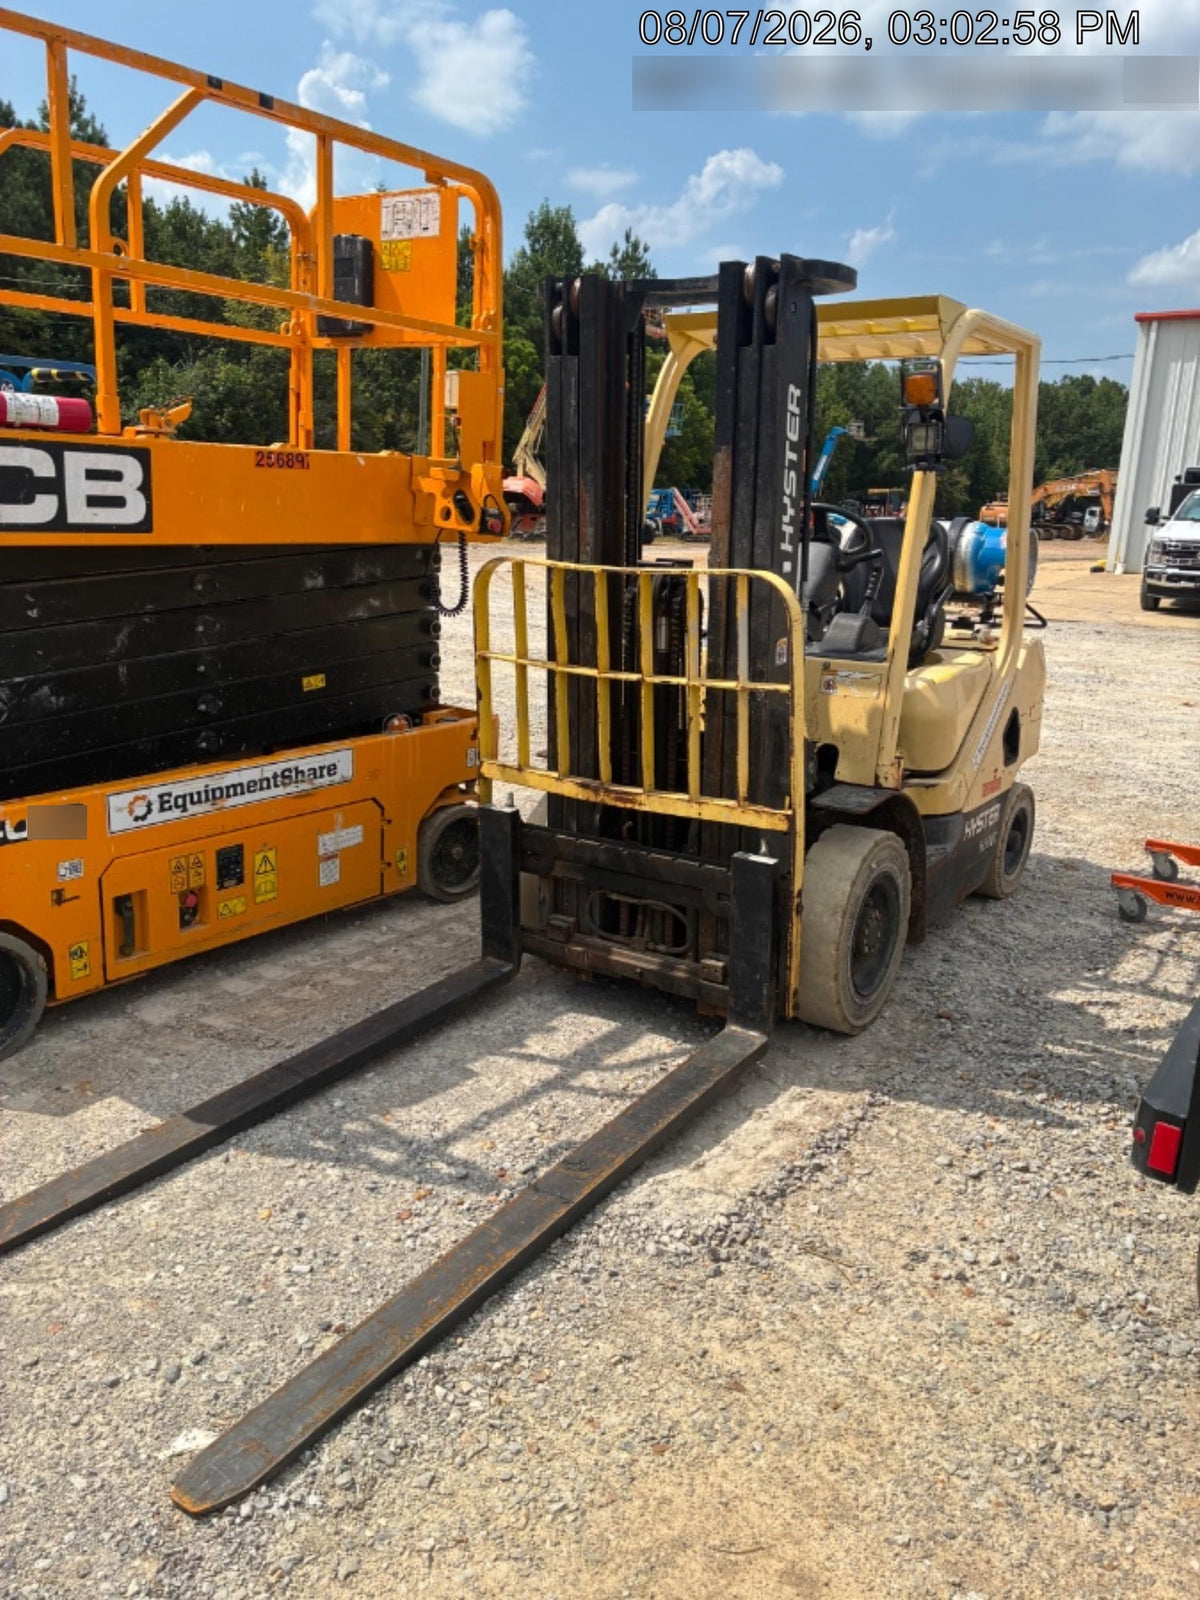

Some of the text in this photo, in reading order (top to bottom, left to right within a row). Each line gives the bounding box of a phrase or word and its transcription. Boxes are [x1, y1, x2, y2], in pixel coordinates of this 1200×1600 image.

[0, 445, 147, 525] CB
[780, 384, 801, 552] HYSTER
[157, 762, 338, 814] EquipmentShare
